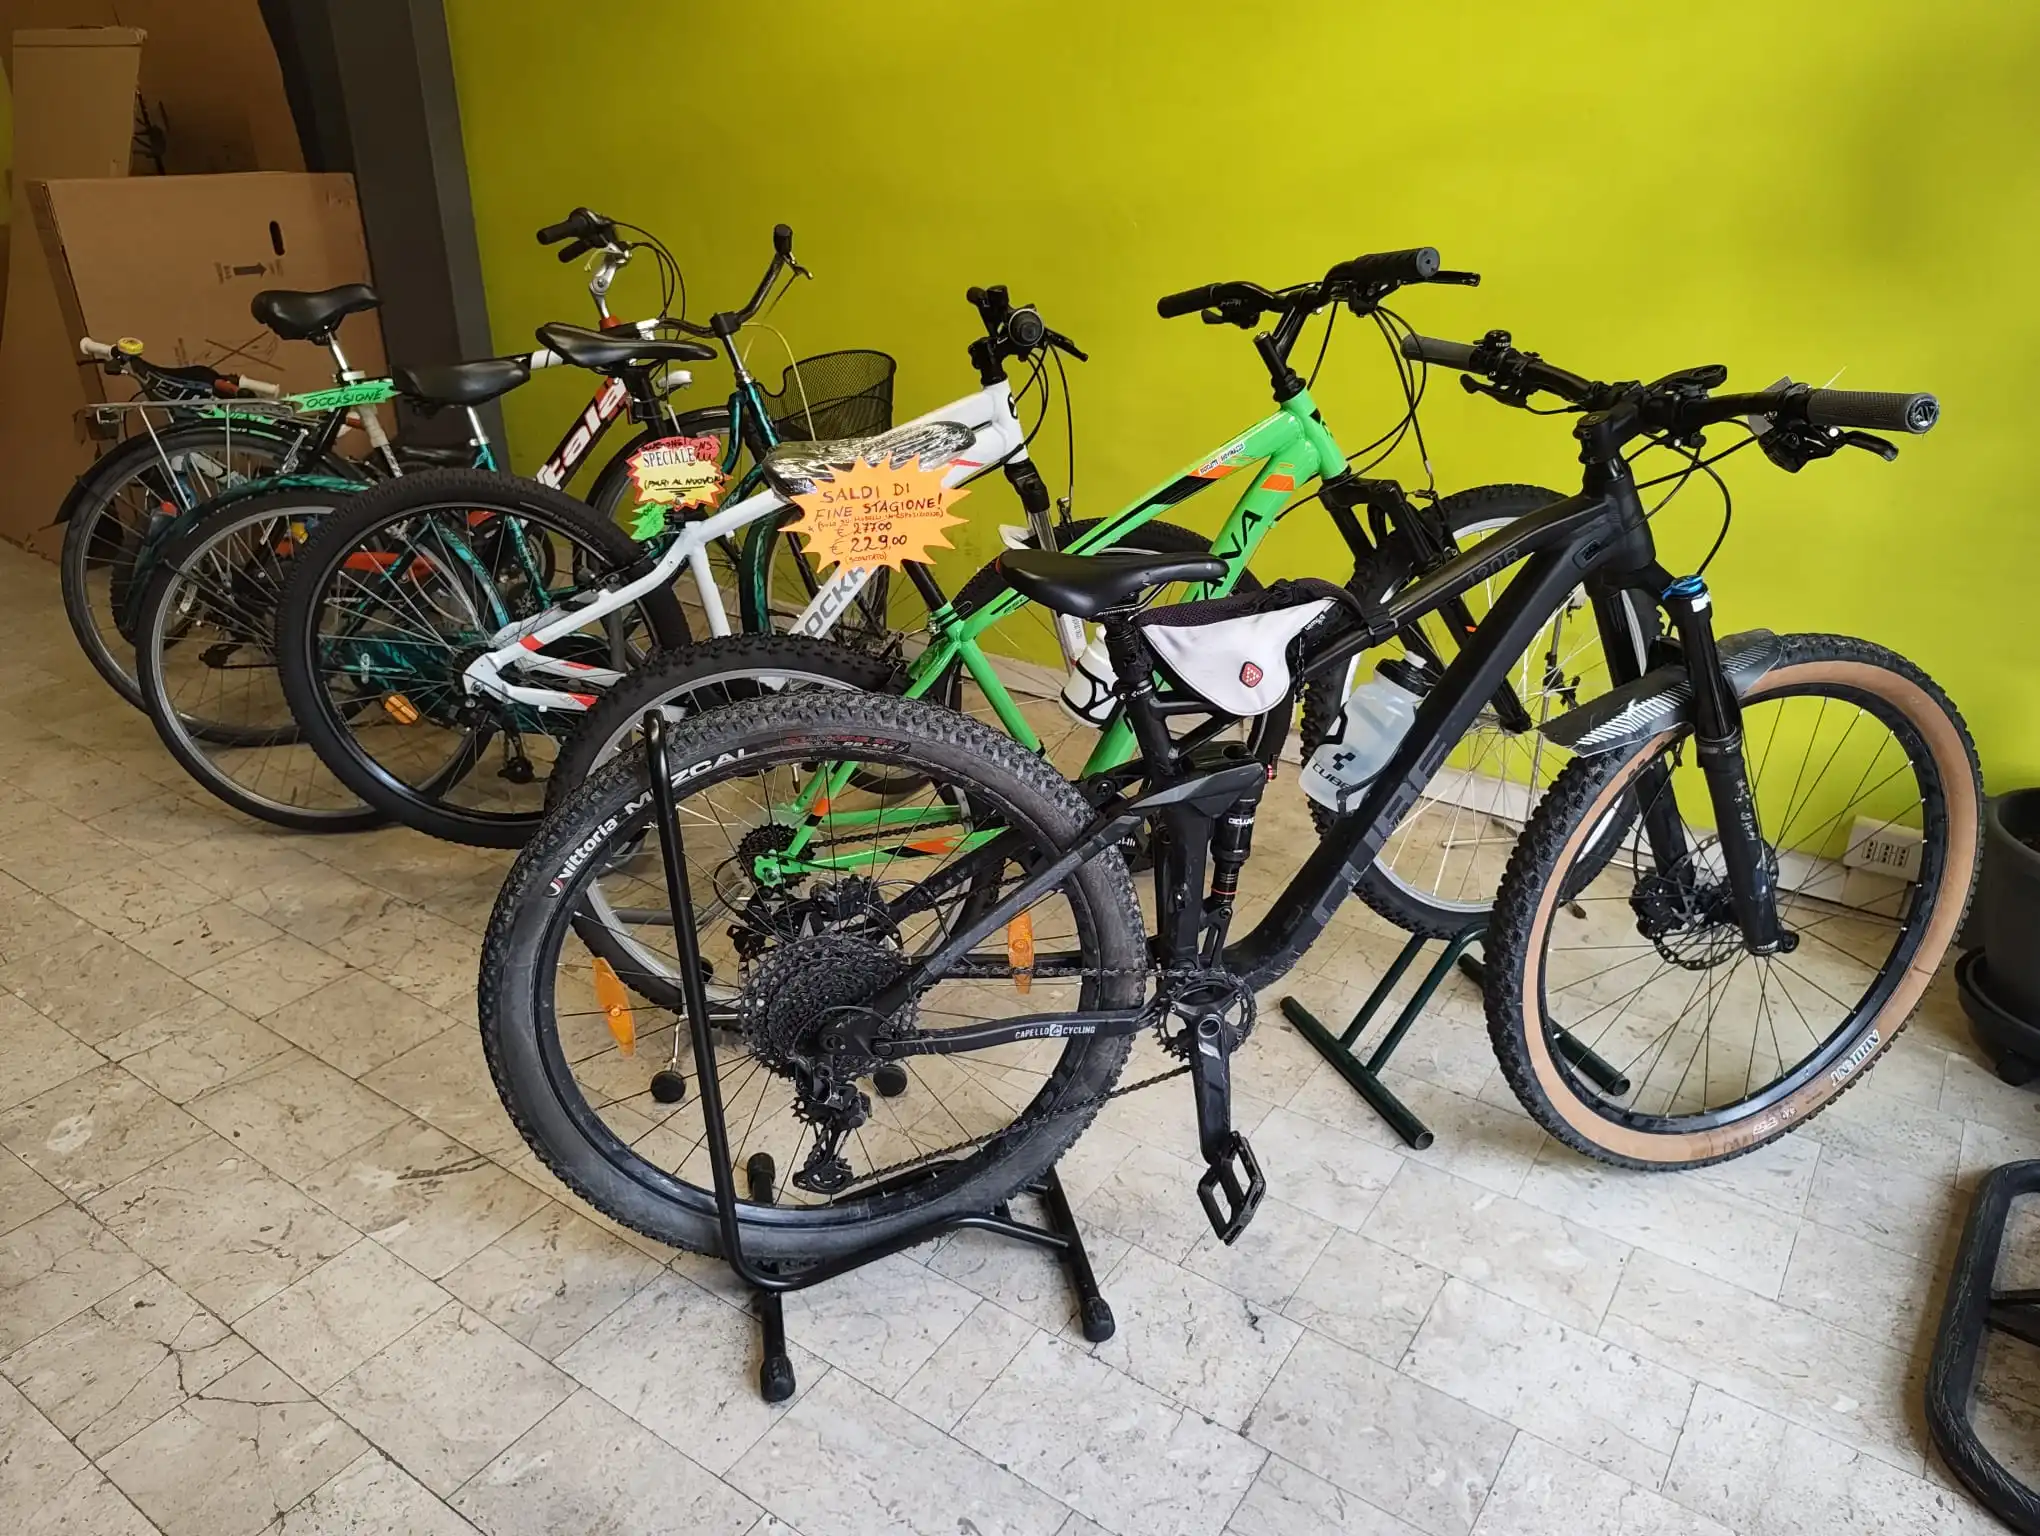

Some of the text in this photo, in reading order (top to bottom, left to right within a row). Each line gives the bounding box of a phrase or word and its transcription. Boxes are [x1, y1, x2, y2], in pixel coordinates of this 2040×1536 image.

[306, 389, 383, 408] OCCASIONE
[642, 447, 697, 468] SPECIALE
[822, 482, 910, 503] SALDI DI
[814, 492, 943, 522] FINE STAGIONE!
[624, 748, 757, 815] MZCAL
[560, 817, 617, 879] Vittoria
[1015, 1025, 1096, 1040] CAPELLO CYCLING
[1830, 1029, 1880, 1087] ARDENT
